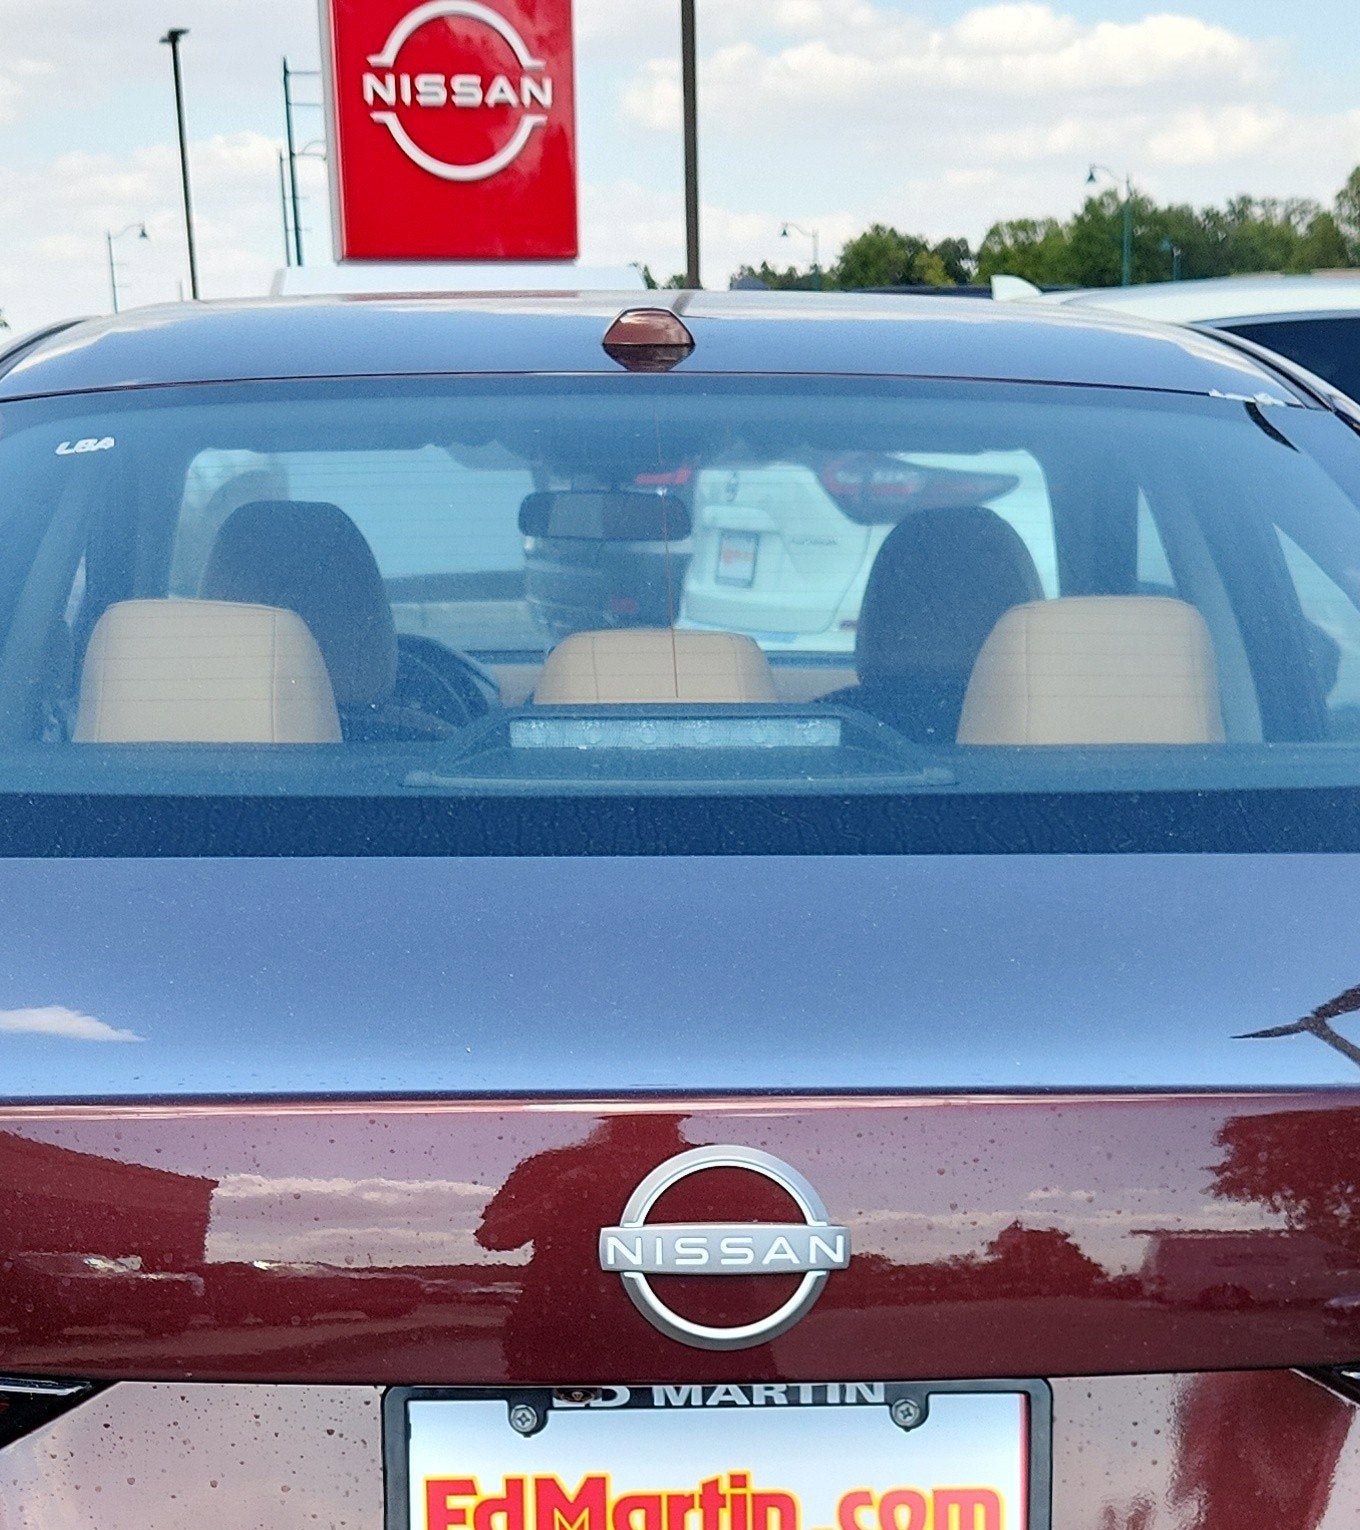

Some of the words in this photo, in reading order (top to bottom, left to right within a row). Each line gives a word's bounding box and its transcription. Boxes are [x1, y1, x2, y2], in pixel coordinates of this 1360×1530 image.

[361, 71, 554, 110] NISSAN
[606, 1233, 847, 1269] NISSAN
[650, 1382, 886, 1407] MARTIN
